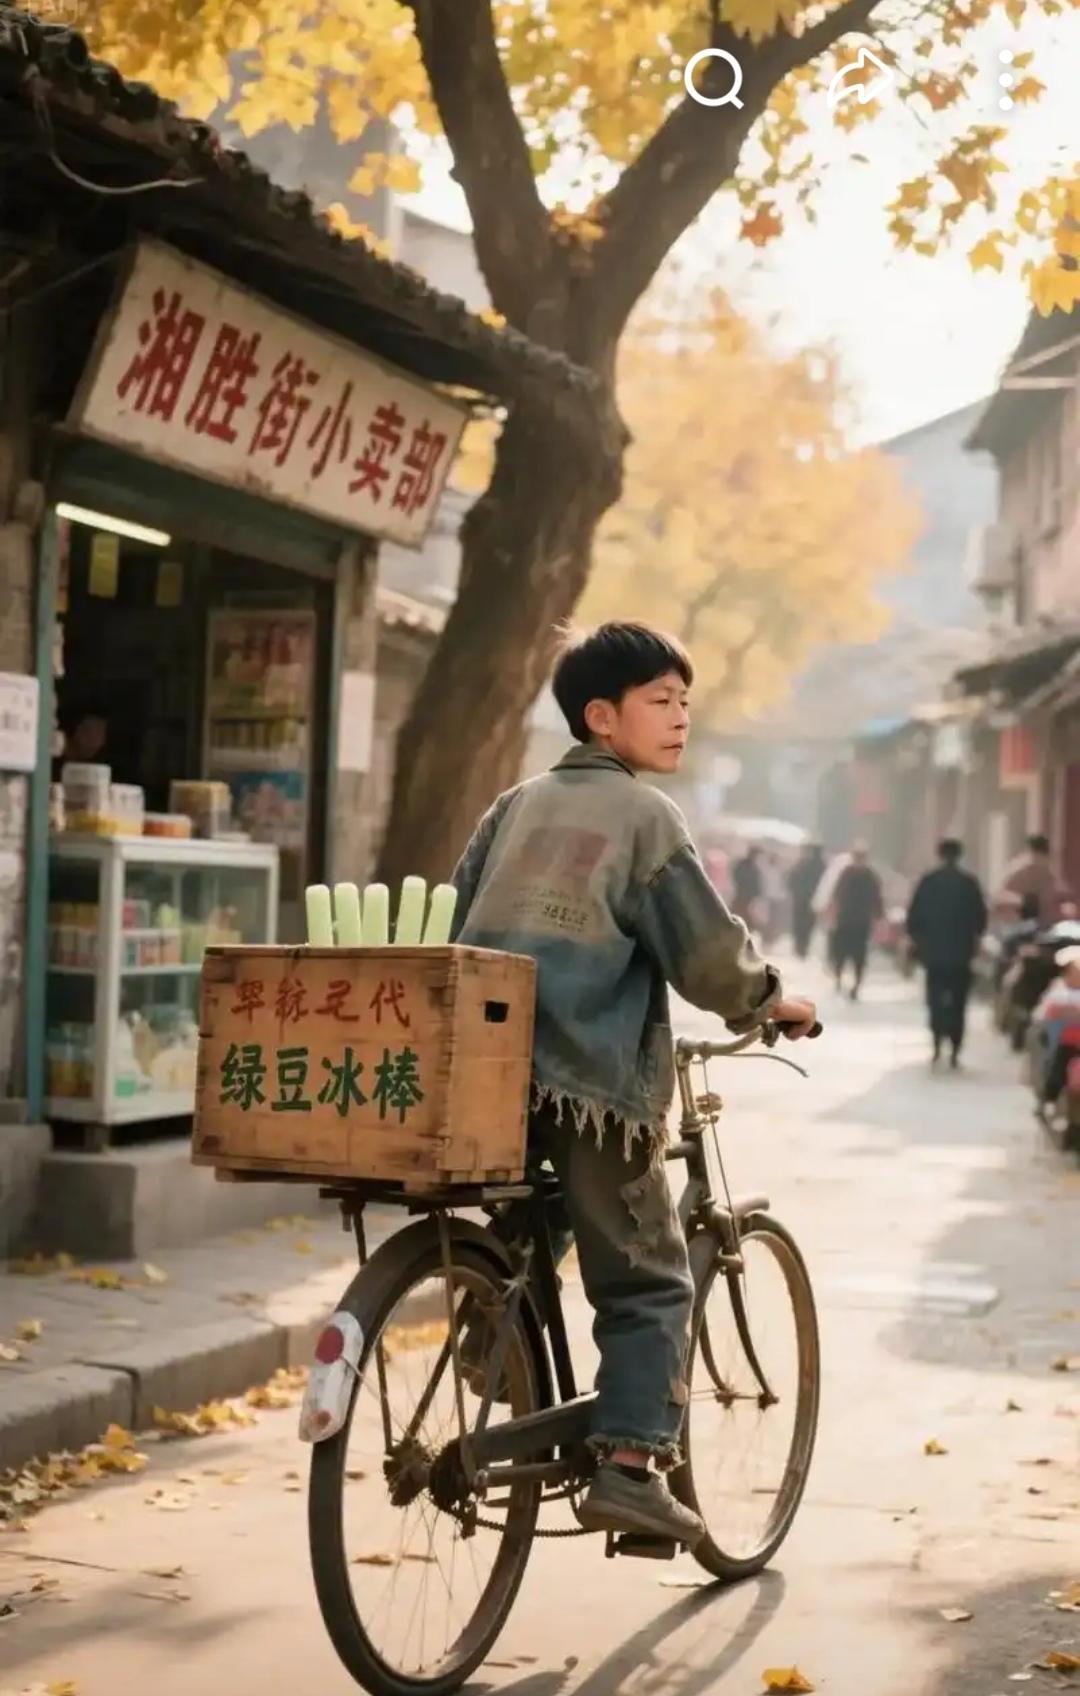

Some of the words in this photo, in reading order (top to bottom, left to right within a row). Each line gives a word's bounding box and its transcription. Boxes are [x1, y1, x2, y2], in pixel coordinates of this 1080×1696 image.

[117, 287, 447, 515] 湘胜街小卖部
[219, 1043, 424, 1123] 绿豆冰棒
